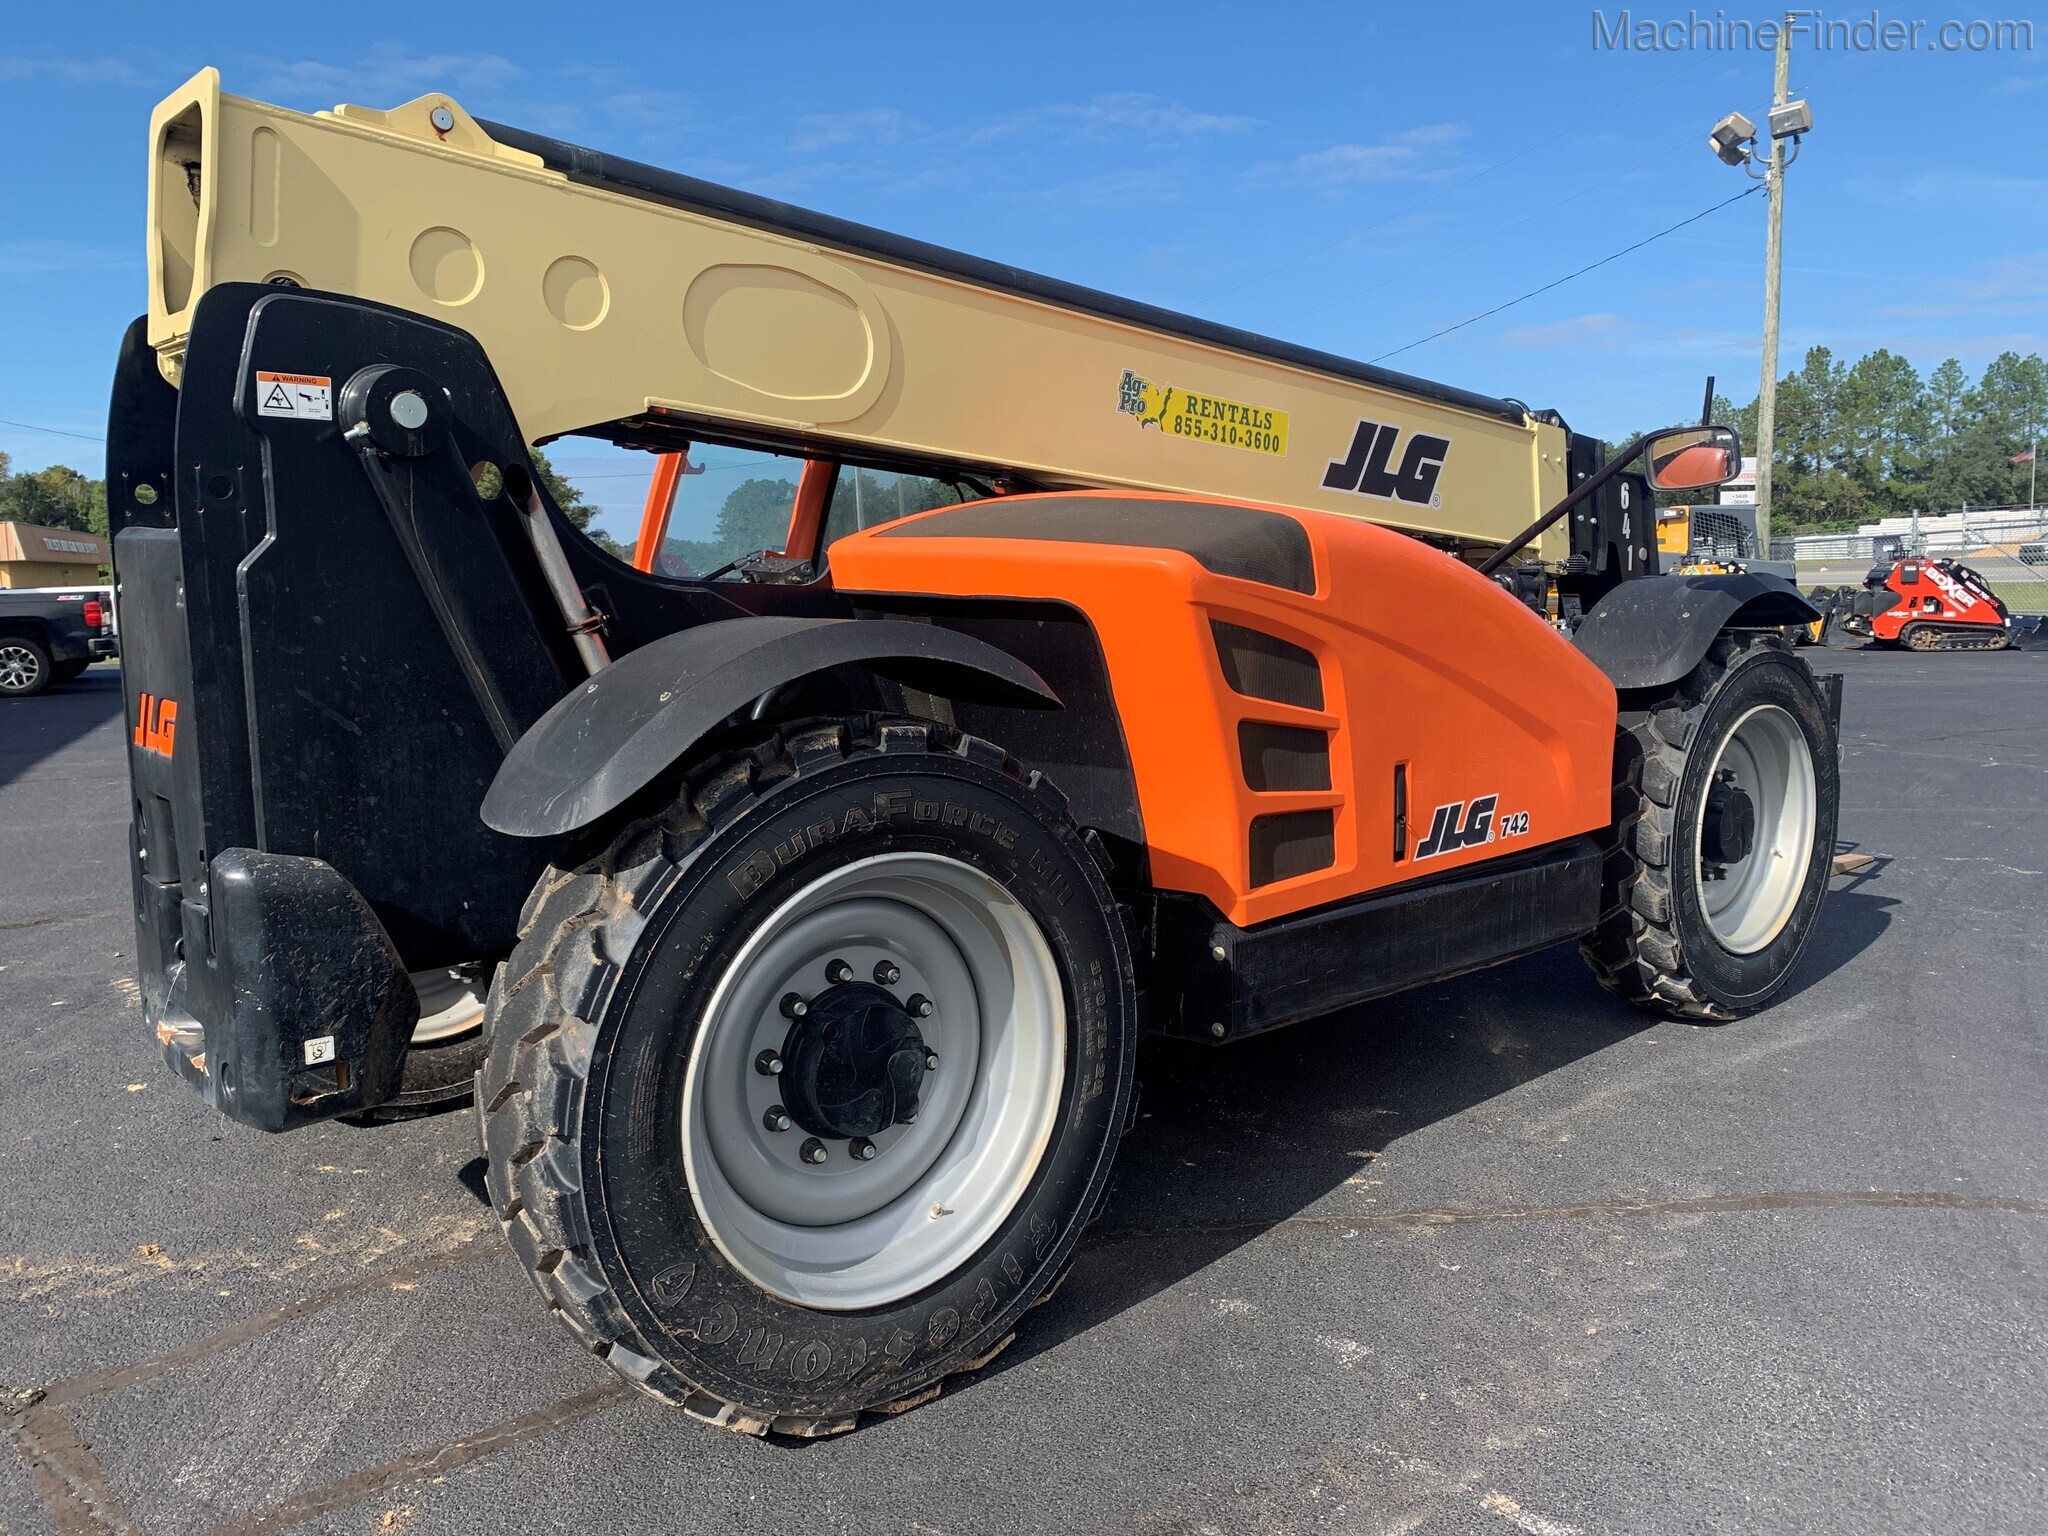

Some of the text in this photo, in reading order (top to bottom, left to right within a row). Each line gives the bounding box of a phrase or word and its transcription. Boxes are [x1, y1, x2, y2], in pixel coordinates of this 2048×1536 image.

[281, 375, 317, 385] WARNING
[1118, 392, 1147, 414] Pro
[1186, 394, 1273, 431] RENTALS
[1174, 415, 1280, 453] 855-310-3600
[1320, 418, 1452, 506] JLG
[1924, 565, 1978, 608] BOXER
[134, 691, 178, 757] JLG
[1415, 795, 1530, 859] JLG 742
